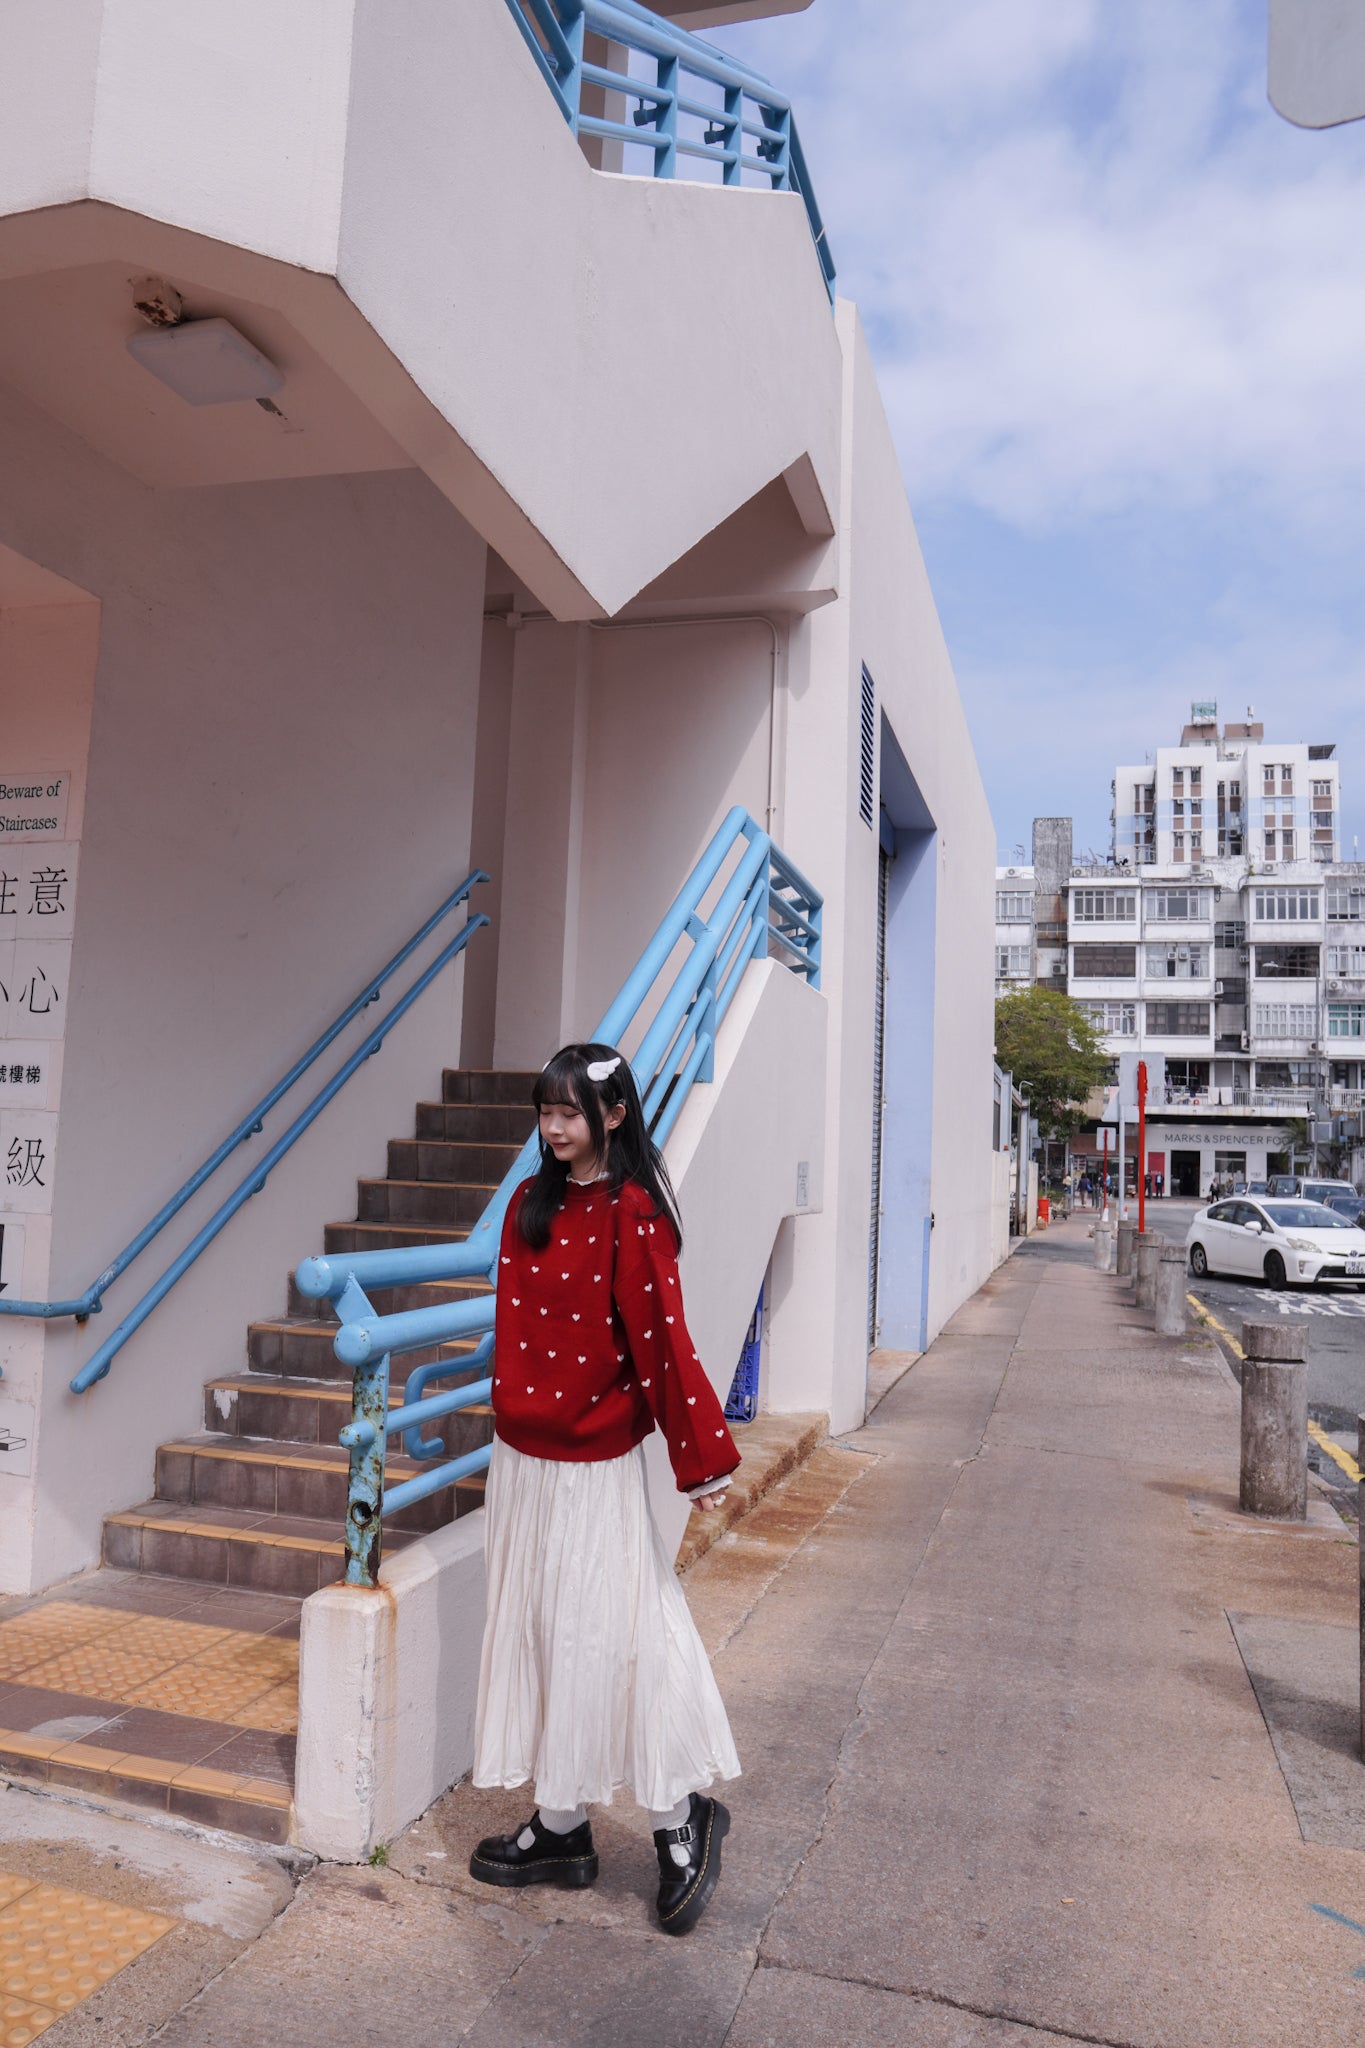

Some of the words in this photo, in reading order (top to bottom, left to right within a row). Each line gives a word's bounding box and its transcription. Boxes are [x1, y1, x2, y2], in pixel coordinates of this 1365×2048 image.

[0, 784, 43, 800] Beware
[47, 780, 62, 797] of
[0, 815, 58, 831] Staircases
[0, 966, 59, 1013] 心
[1164, 1133, 1202, 1143] MARKS
[1204, 1134, 1211, 1143] &
[1212, 1134, 1264, 1145] SPENCER
[1266, 1135, 1293, 1145] FOO
[6, 1136, 45, 1187] 級
